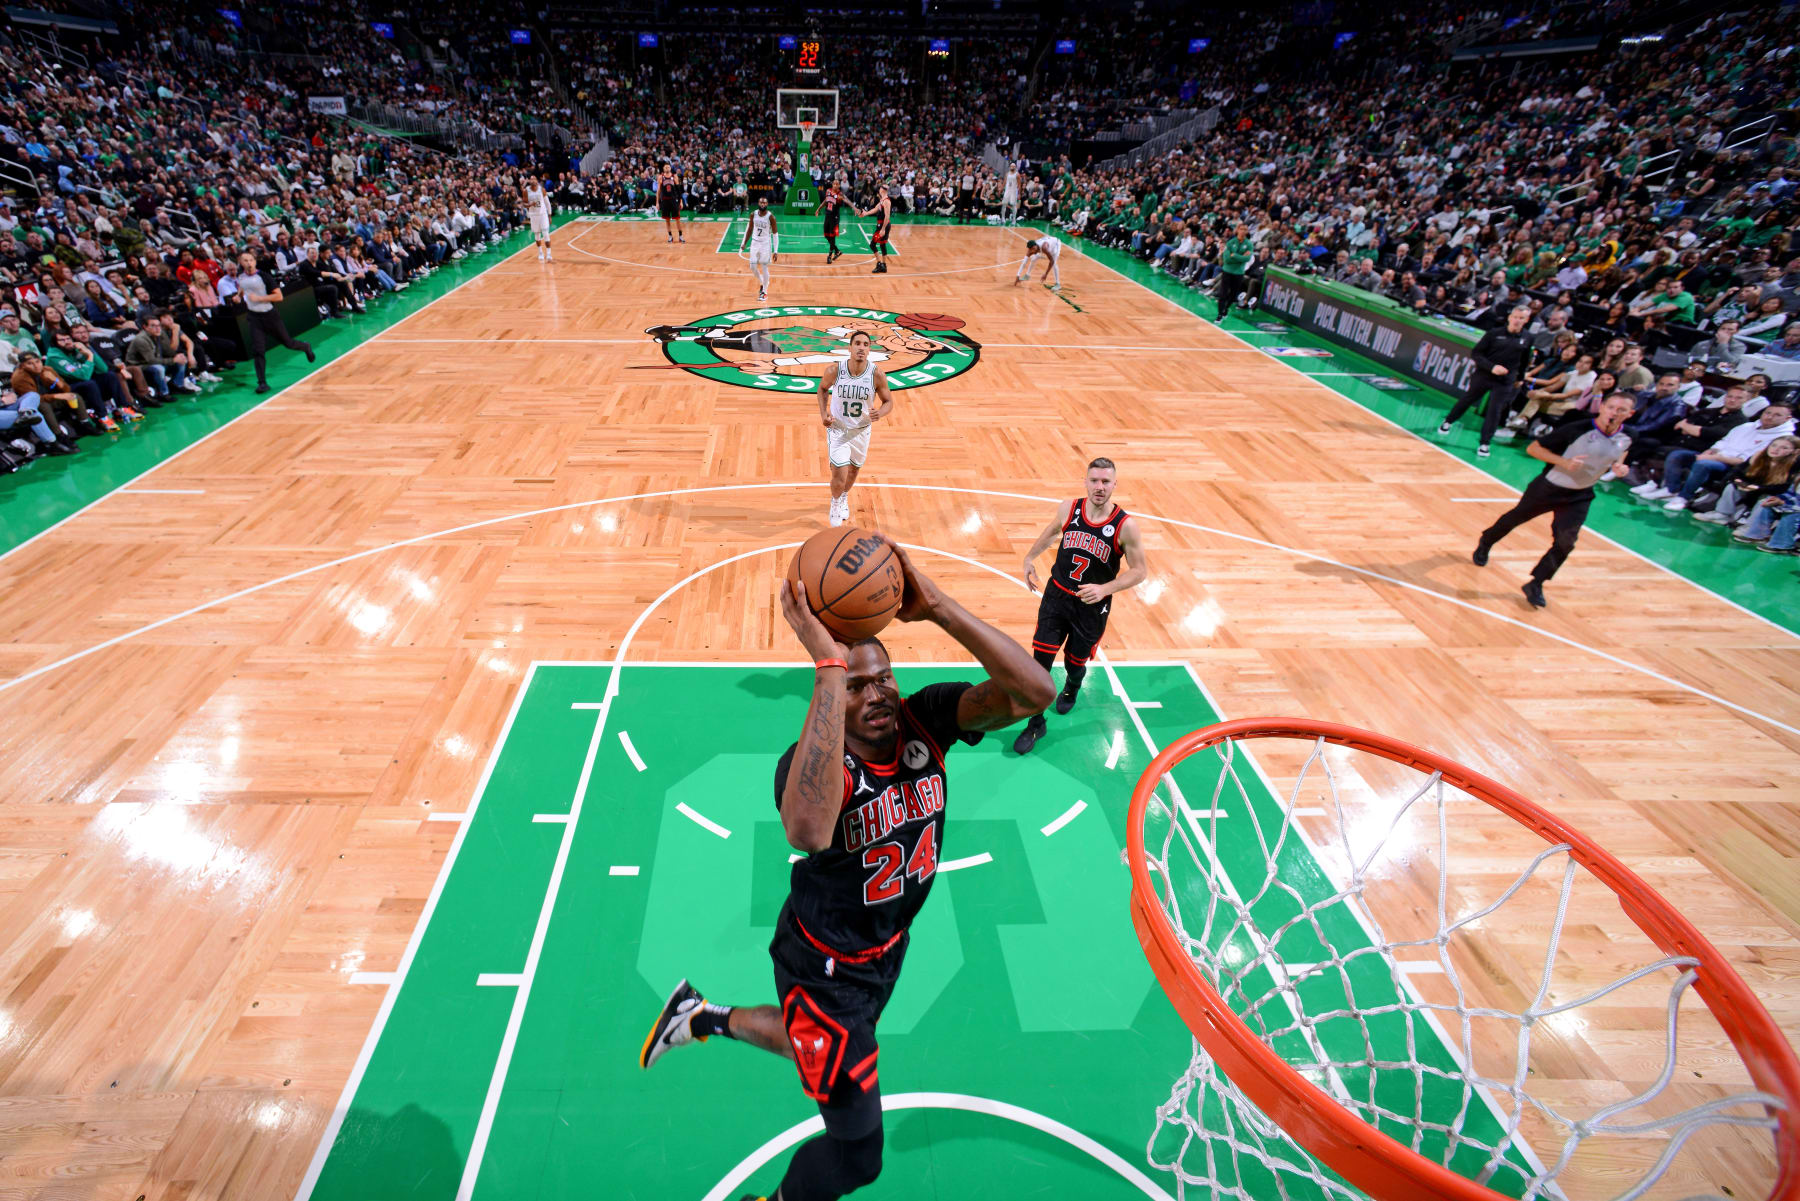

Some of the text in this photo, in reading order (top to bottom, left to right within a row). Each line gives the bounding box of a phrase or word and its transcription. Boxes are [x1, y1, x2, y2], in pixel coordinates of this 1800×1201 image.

[800, 51, 817, 66] 22
[802, 42, 819, 52] 5:23
[723, 306, 891, 322] BOSTON
[1271, 284, 1305, 317] Pick'Em
[1313, 302, 1402, 358] PICK. WATCH. WIN!
[1424, 345, 1476, 392] Pick'E
[838, 384, 869, 400] CELTICS
[842, 401, 863, 417] 13
[835, 535, 884, 575] Wilso
[1063, 531, 1111, 563] CHICAGO
[1069, 554, 1090, 581] 7
[843, 774, 945, 852] CHICAGO
[862, 820, 939, 906] 24
